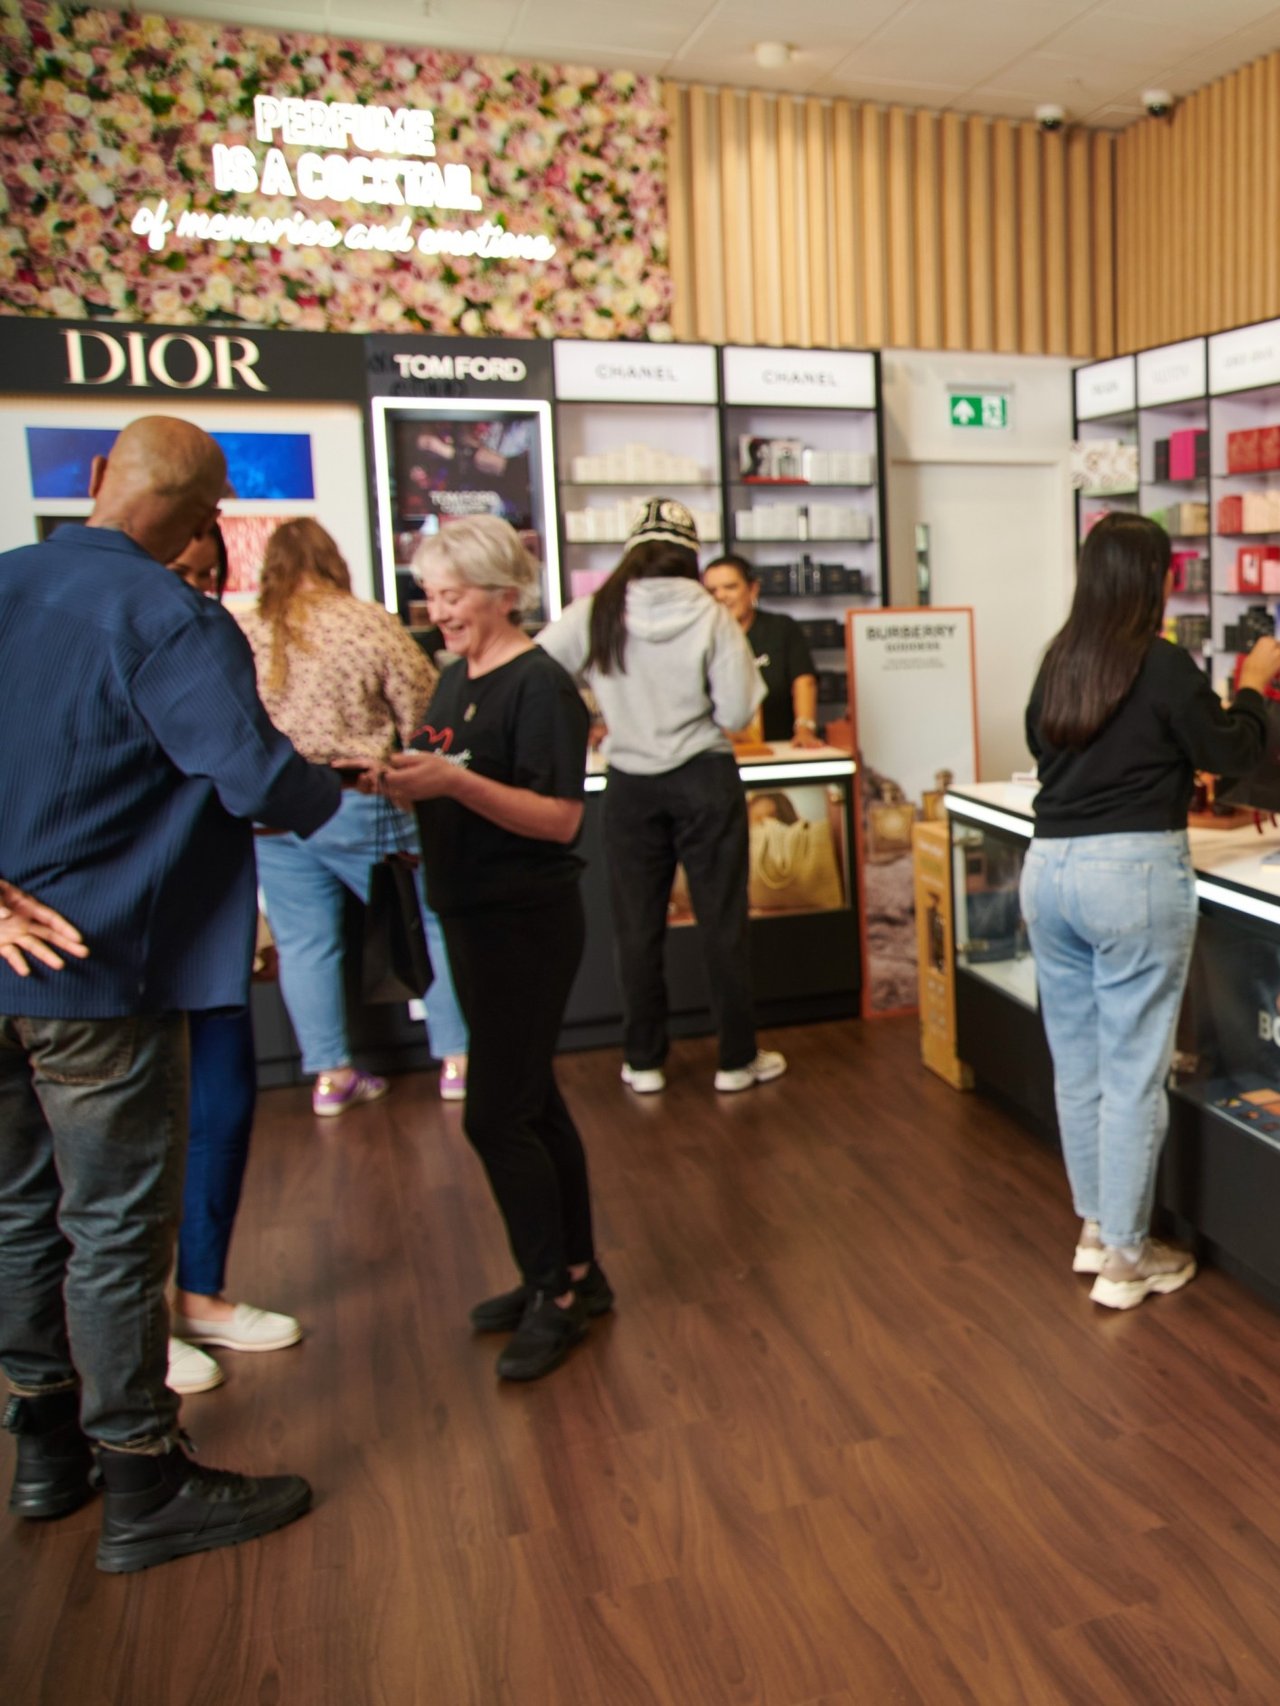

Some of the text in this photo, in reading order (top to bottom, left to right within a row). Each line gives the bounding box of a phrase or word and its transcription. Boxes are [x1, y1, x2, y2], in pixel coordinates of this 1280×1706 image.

[254, 94, 436, 157] PERFUME
[212, 143, 482, 211] IS A COCKTAIL
[131, 198, 556, 262] of memories and emotions
[61, 328, 271, 392] DIOR
[393, 354, 527, 382] TOM FORD
[595, 364, 679, 382] CHANEL
[762, 370, 838, 387] CHANEL
[865, 624, 956, 641] BURBERRY
